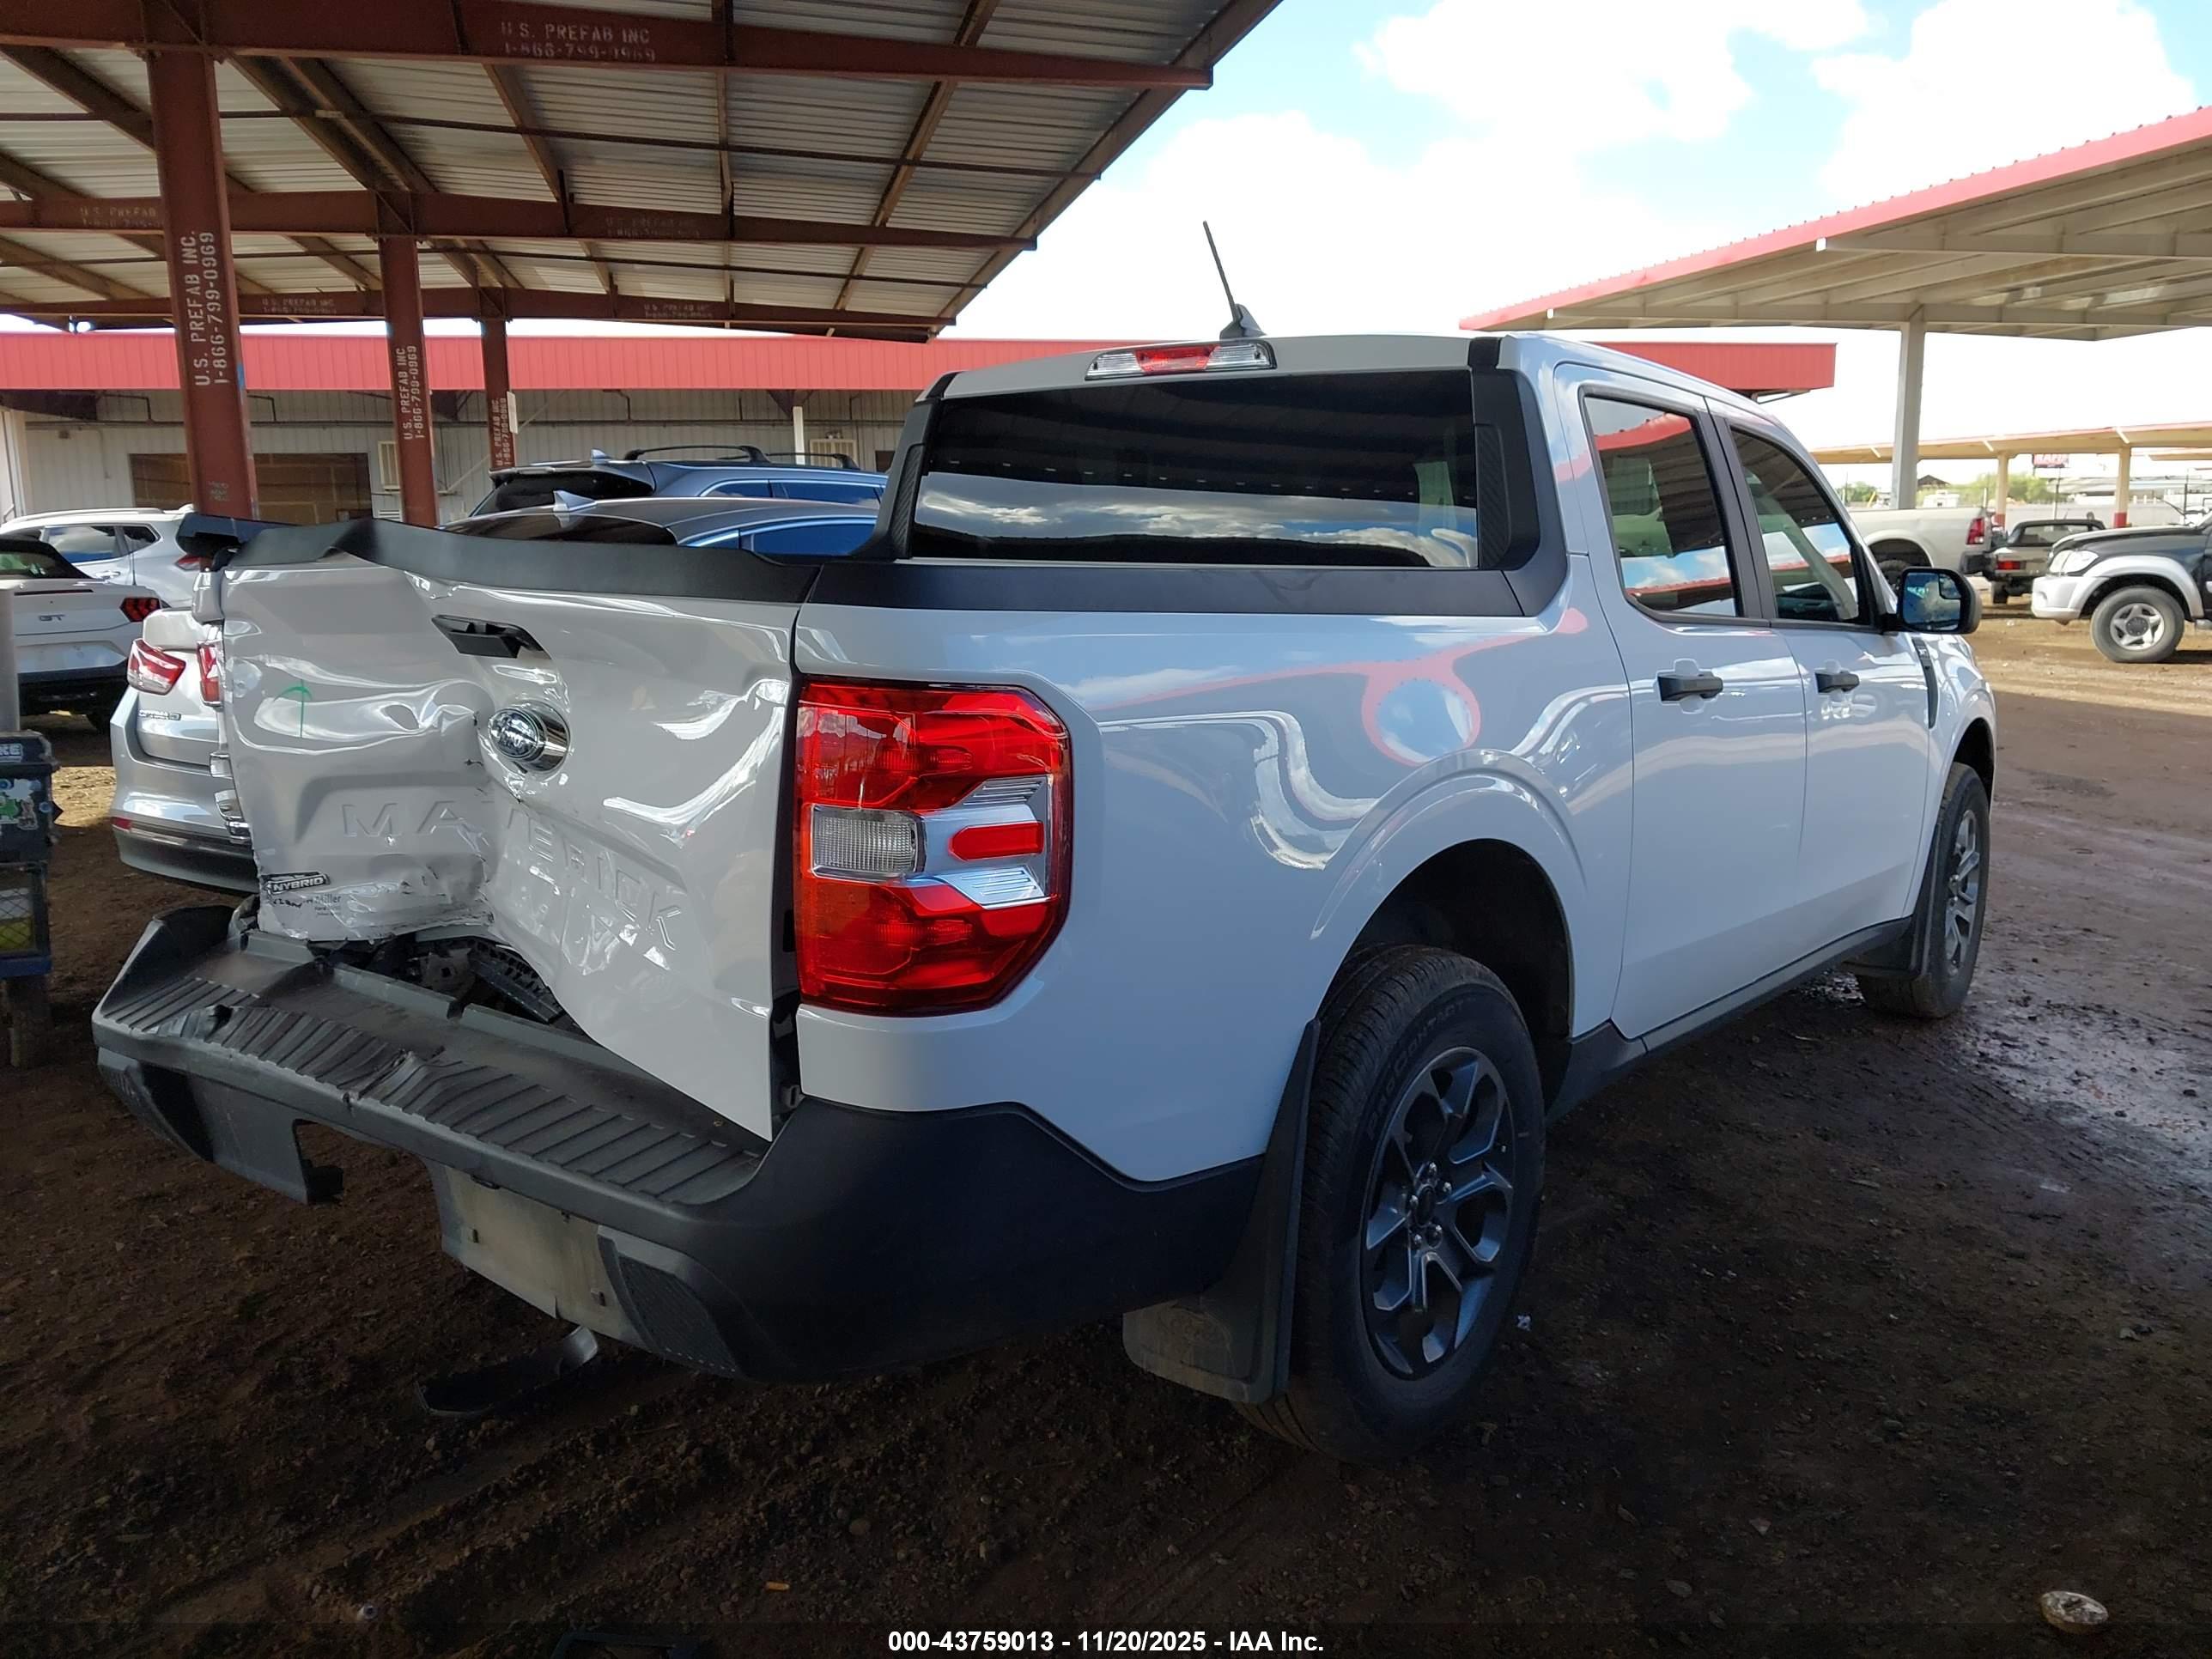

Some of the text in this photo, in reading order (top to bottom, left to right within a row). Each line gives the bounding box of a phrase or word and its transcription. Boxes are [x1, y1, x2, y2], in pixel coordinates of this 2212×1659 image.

[545, 23, 614, 42] PREFAB
[622, 27, 650, 44] INC
[180, 231, 211, 386] U.S. PREFAB INC.
[199, 232, 230, 384] 1-866-799-0969
[398, 371, 410, 413] PREFAB
[403, 419, 413, 440] U.S.
